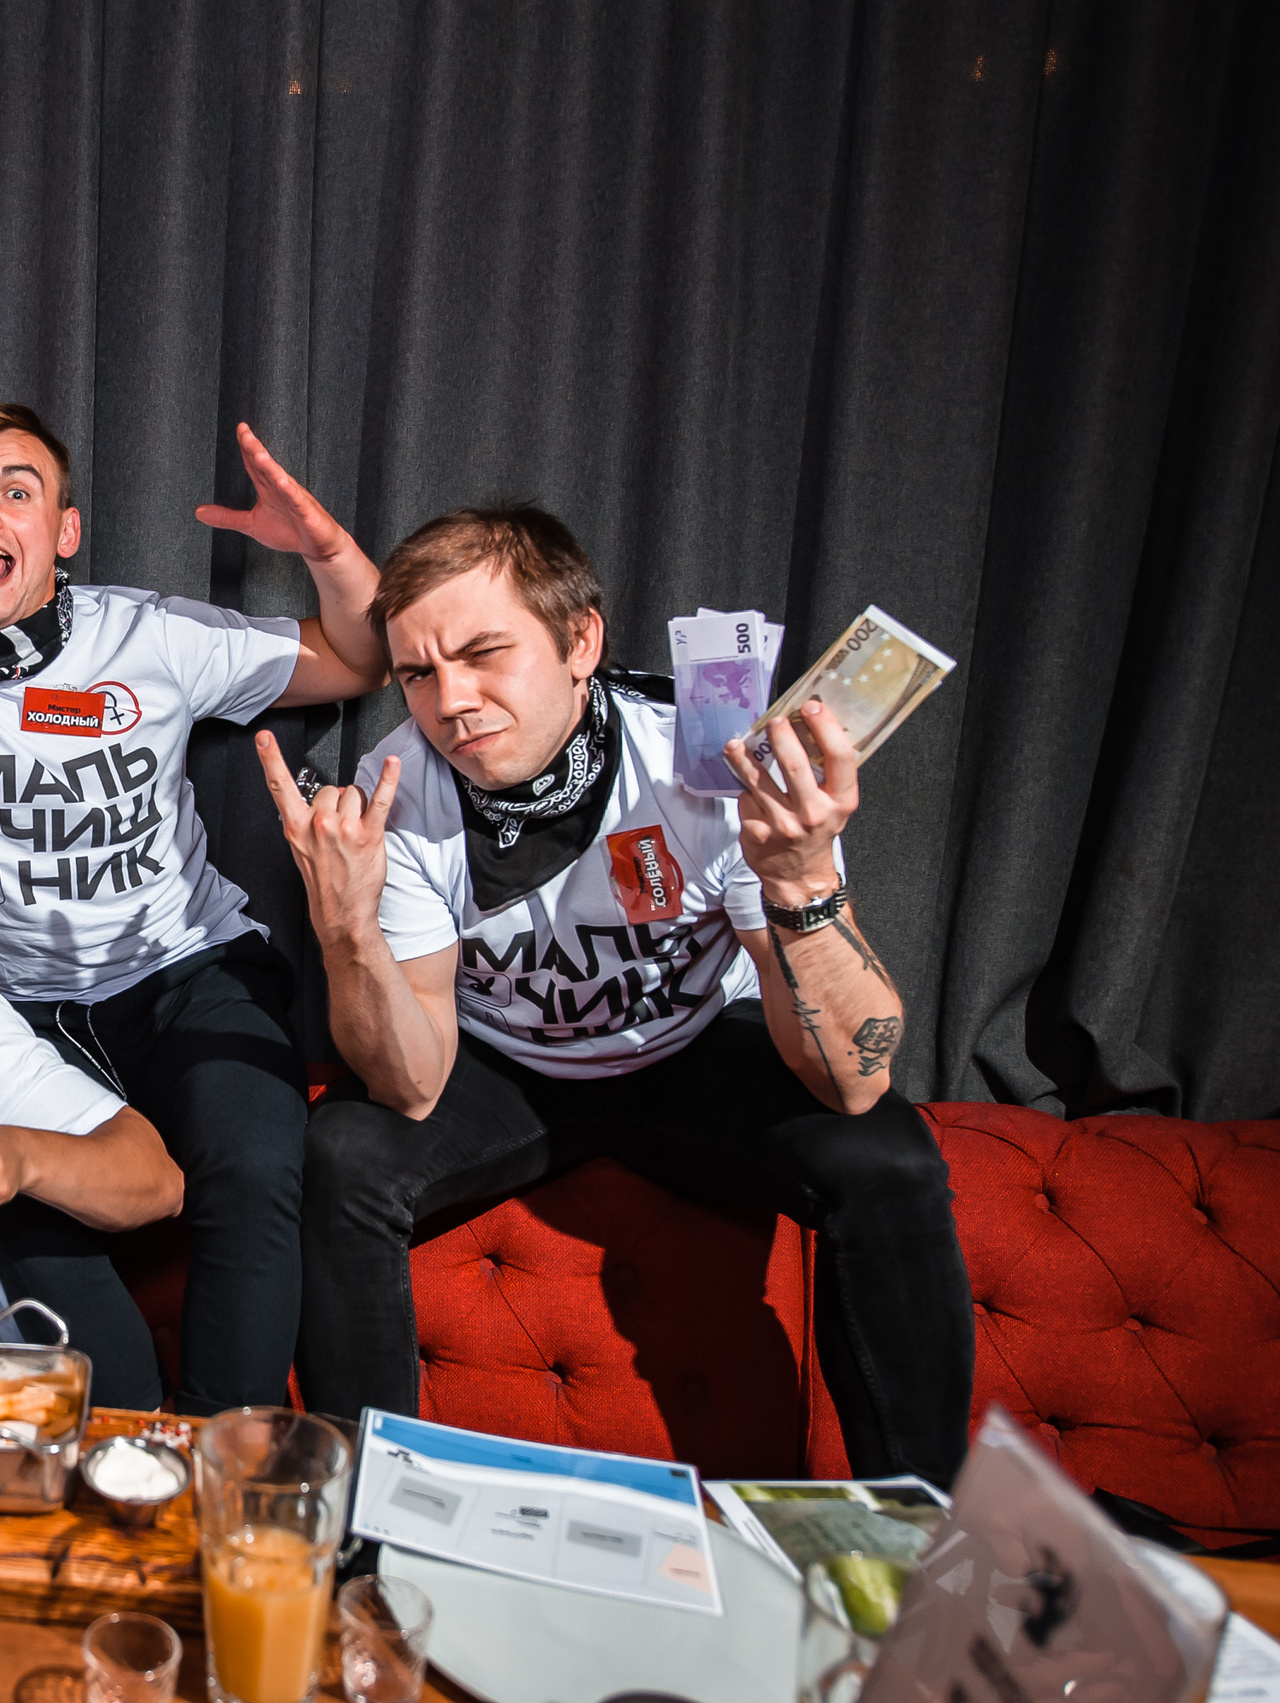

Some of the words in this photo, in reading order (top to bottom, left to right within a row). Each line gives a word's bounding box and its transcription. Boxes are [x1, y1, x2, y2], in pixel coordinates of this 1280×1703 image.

[735, 623, 751, 653] 500
[27, 711, 99, 728] ХОЛОДНЫЙ
[47, 704, 81, 714] Мистер
[0, 780, 163, 852] ЧИШ
[18, 831, 165, 906] НИК
